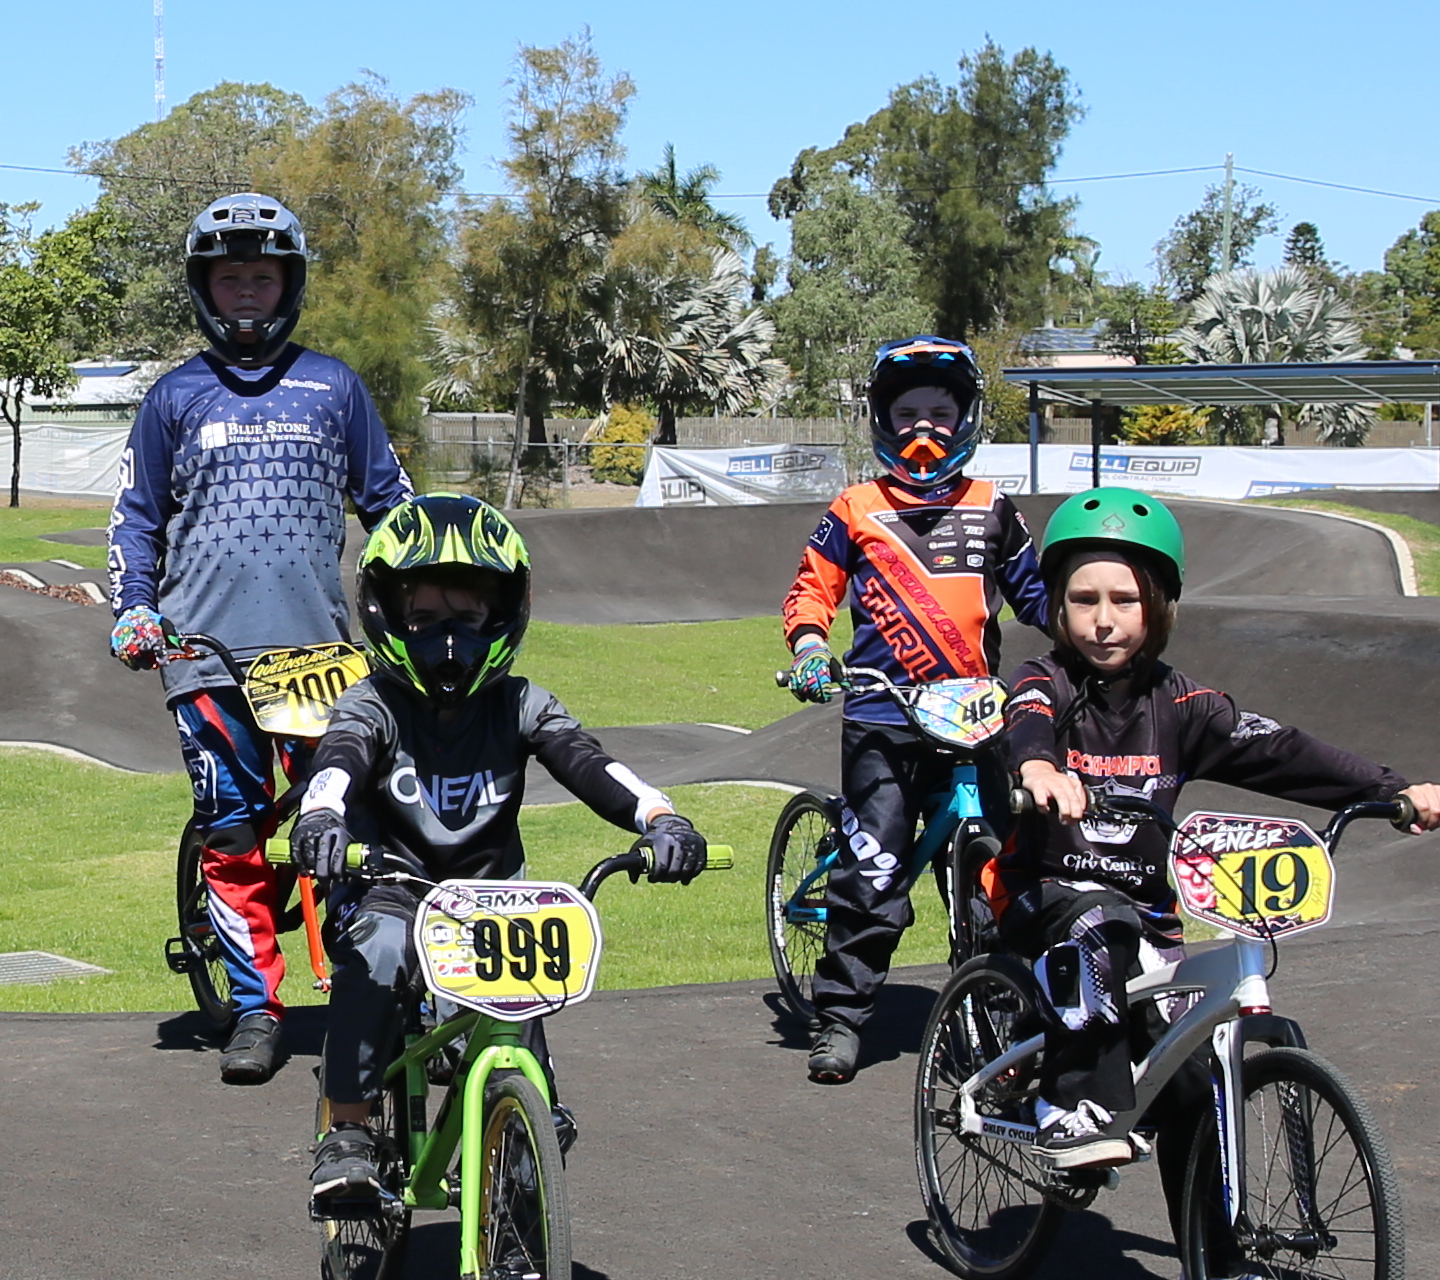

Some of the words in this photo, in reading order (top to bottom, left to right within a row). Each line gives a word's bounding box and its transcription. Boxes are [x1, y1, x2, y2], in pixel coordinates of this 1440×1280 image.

[227, 423, 264, 435] BLUE
[267, 421, 311, 435] STONE
[729, 461, 769, 472] BELL
[774, 454, 822, 469] EQUIP
[1129, 460, 1195, 473] EQUIP
[252, 648, 336, 678] QUEENSLAND
[287, 666, 348, 721] 100
[962, 692, 997, 725] 46
[390, 766, 512, 818] ONEAL
[1182, 828, 1285, 855] SPENCER
[1233, 852, 1310, 916] 19
[476, 892, 536, 908] BMX
[473, 918, 571, 982] 999
[983, 1122, 1006, 1136] OXLEY
